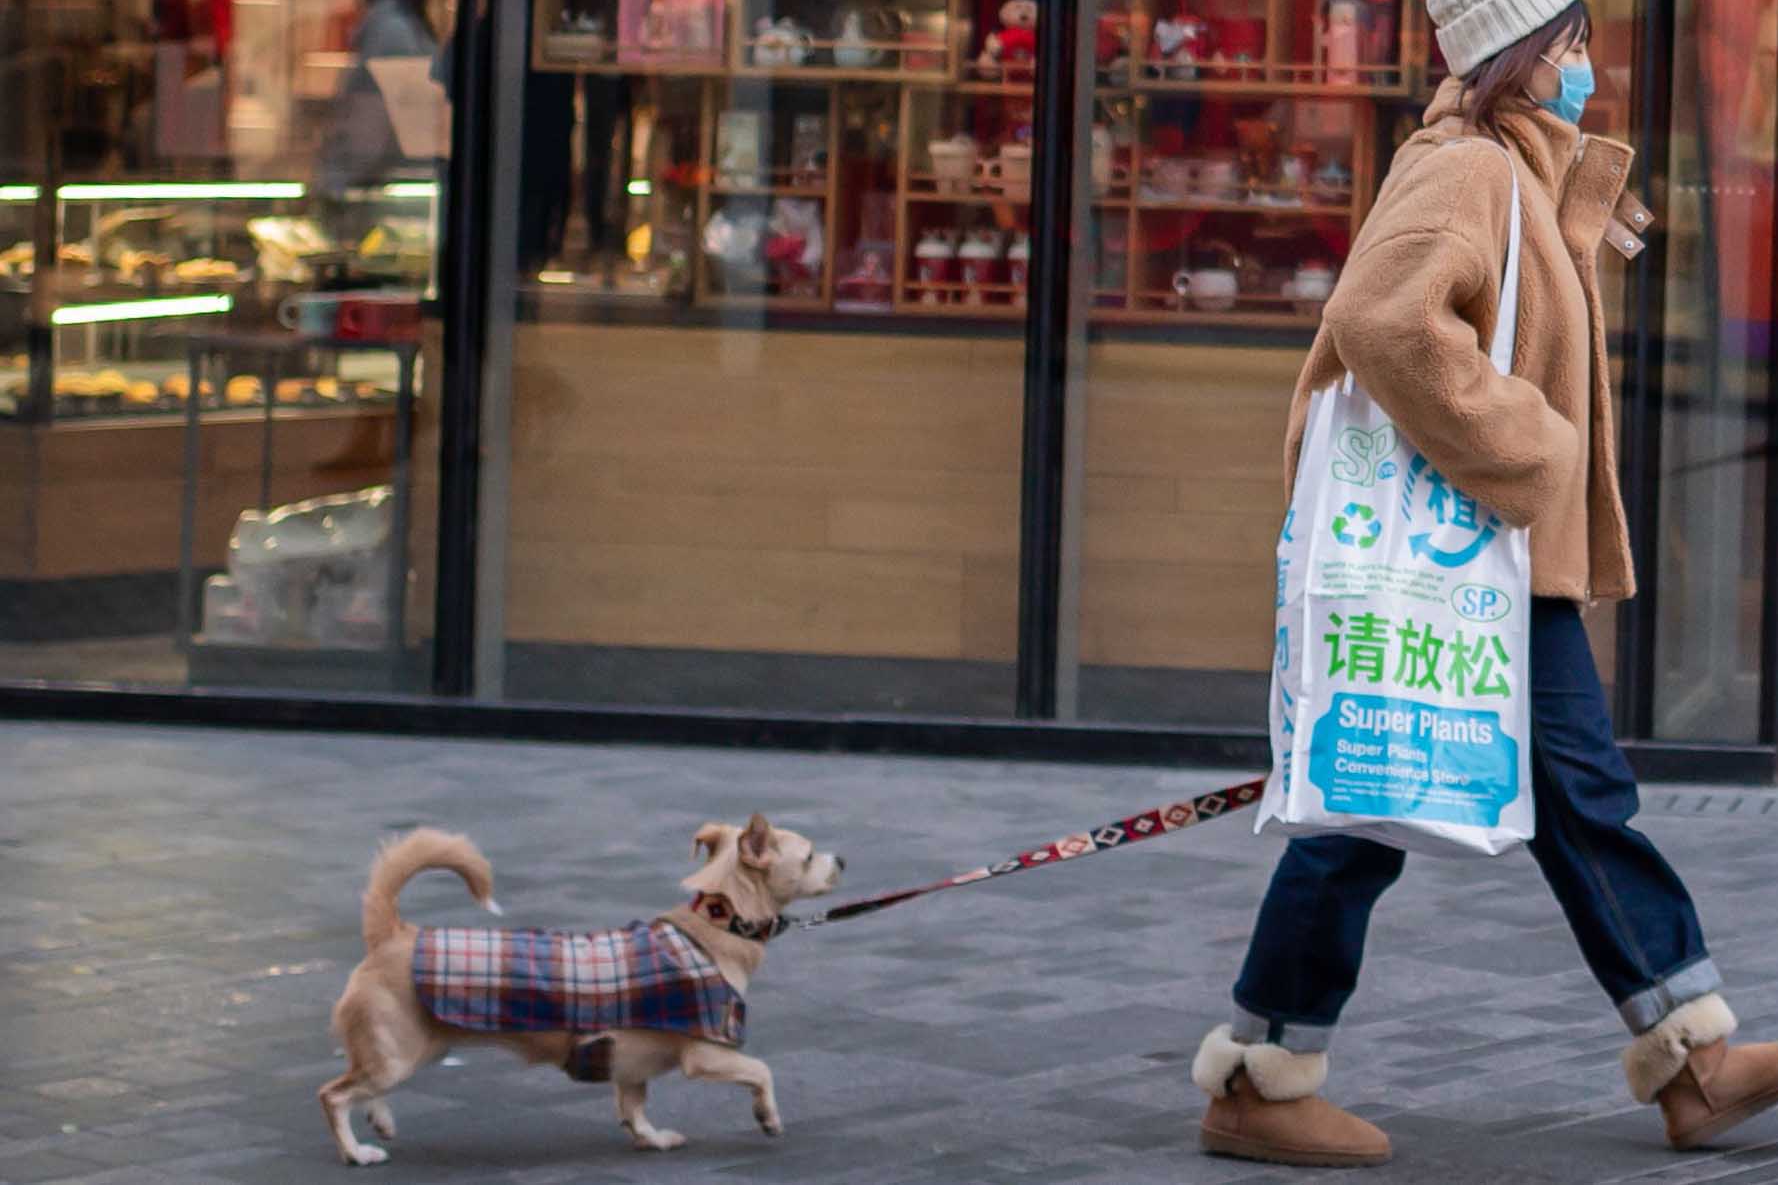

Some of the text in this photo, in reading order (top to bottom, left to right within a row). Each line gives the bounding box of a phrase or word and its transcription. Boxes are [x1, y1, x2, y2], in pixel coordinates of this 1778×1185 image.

[1323, 611, 1512, 698] 请放松
[1338, 699, 1494, 745] Super Plants
[1336, 738, 1384, 757] Super
[1334, 757, 1430, 783] Convenience
